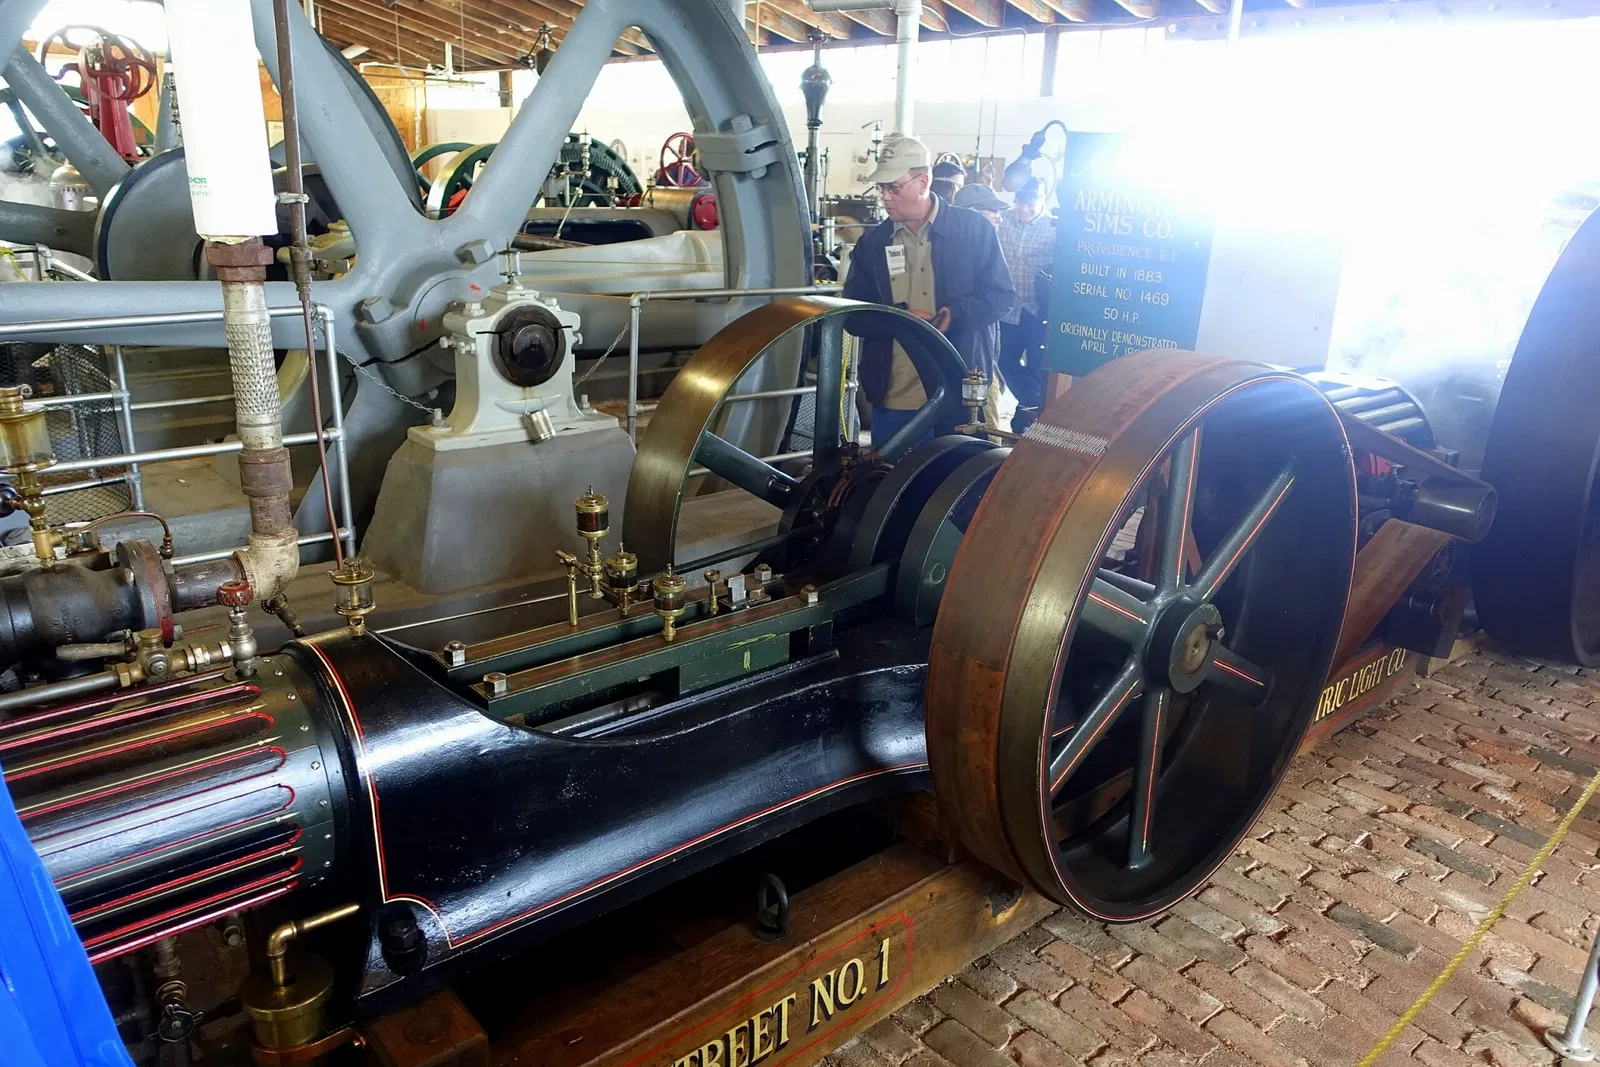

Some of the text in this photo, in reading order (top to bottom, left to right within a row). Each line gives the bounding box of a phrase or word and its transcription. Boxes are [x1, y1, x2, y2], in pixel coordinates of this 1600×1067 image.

[1073, 187, 1167, 217] ARMINGT
[1083, 212, 1174, 239] SIMS CO.
[1080, 262, 1162, 283] BUILT IN 1883
[1073, 282, 1170, 306] SERIAL NO. 1469
[1103, 307, 1140, 325] 50 H.P.
[1060, 321, 1178, 350] ORIGINALLY DEMONSTRATED
[1080, 340, 1108, 354] APRIL
[1347, 655, 1388, 702] LIGHT
[1387, 647, 1407, 676] CO.
[670, 937, 890, 1067] TREET NO. 1
